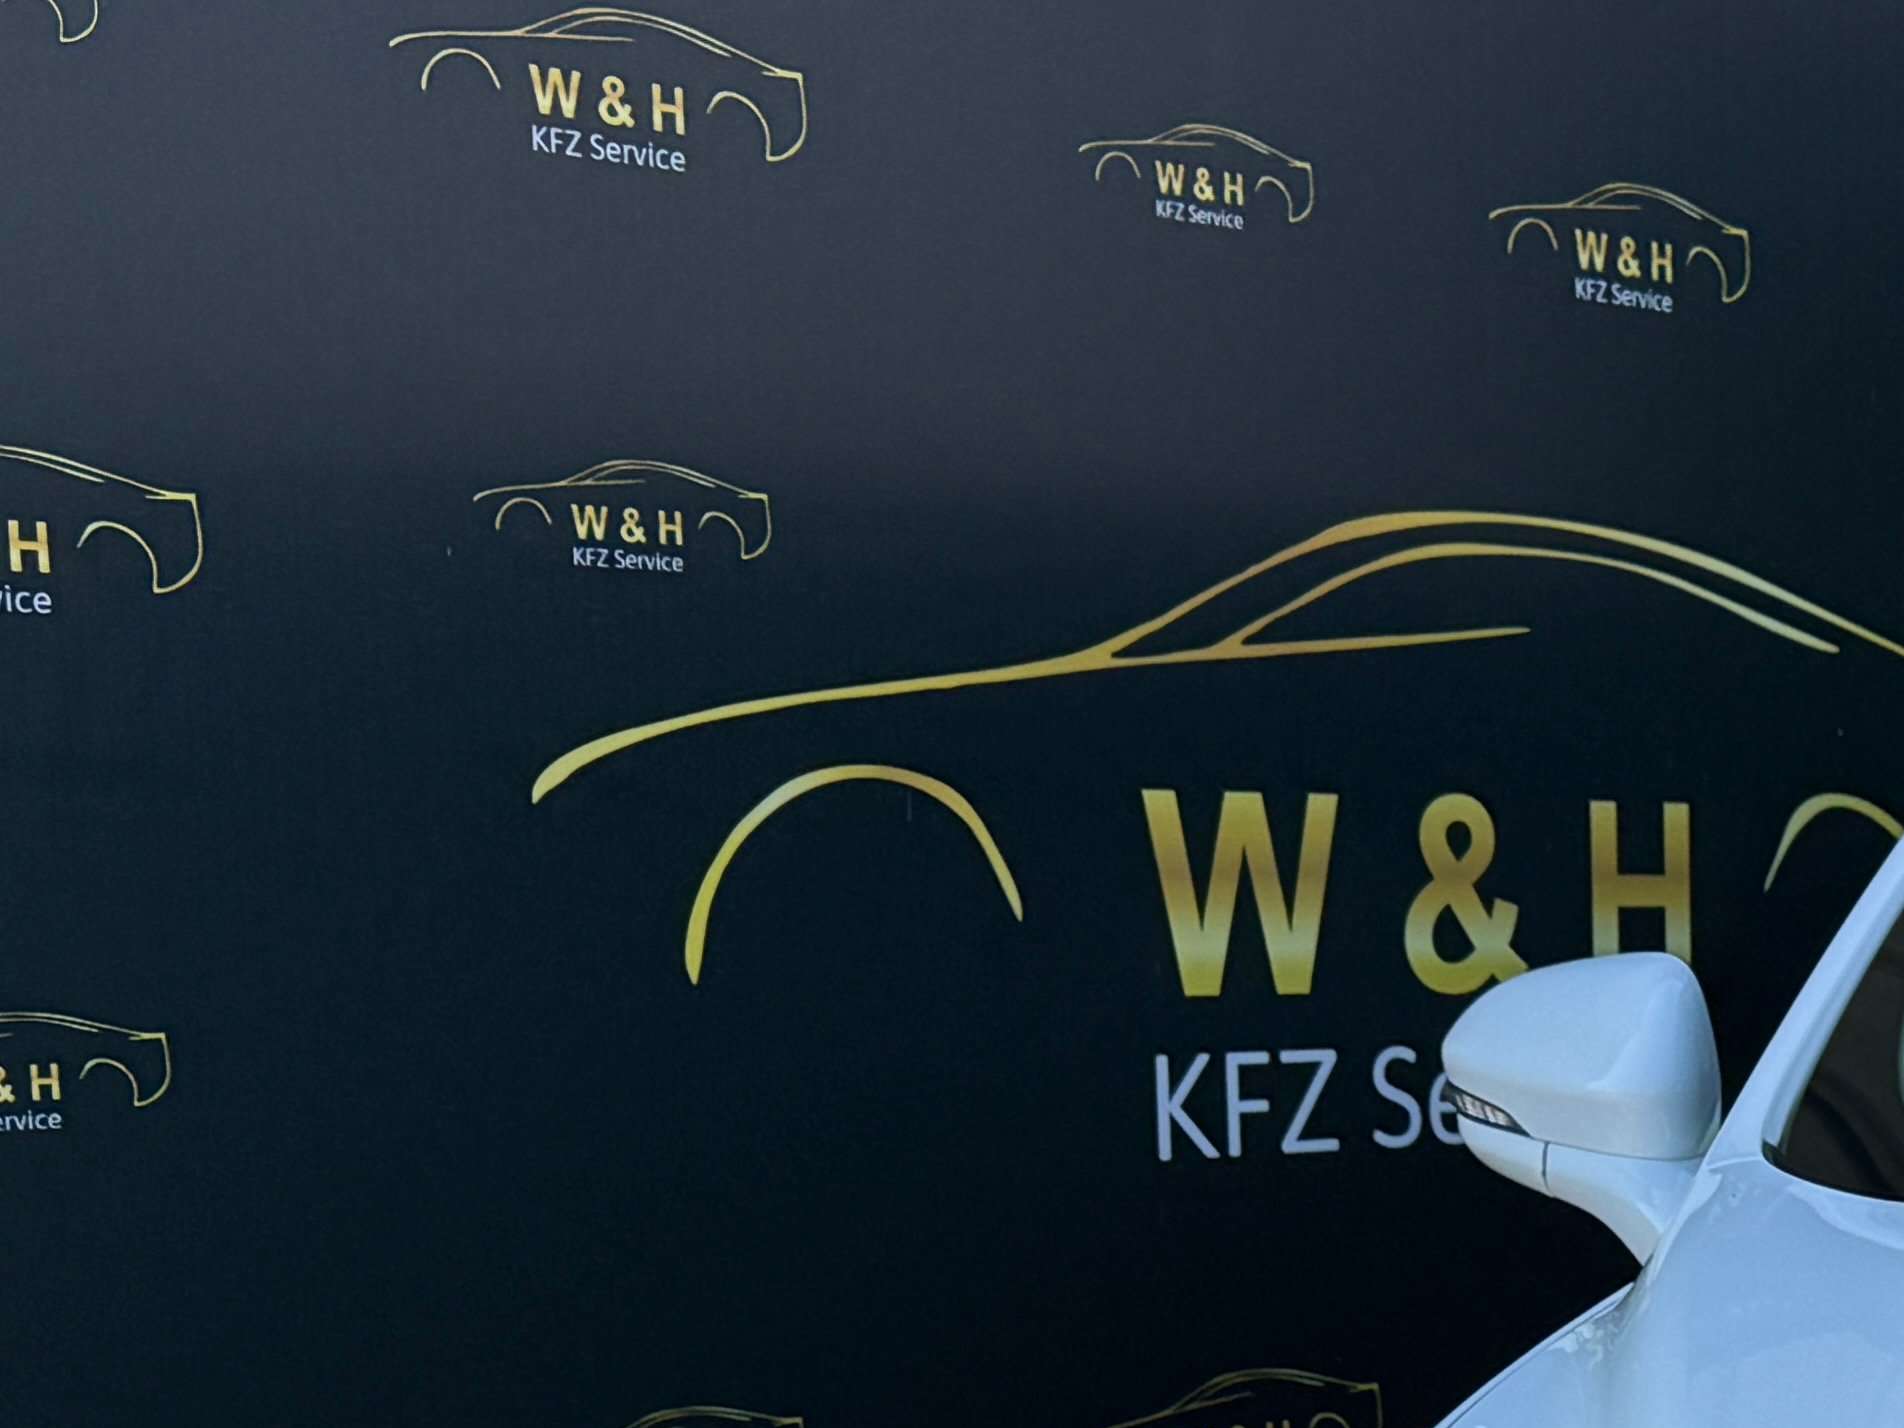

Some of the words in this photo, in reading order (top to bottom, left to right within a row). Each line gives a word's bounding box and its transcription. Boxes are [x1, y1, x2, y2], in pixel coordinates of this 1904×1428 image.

[528, 63, 581, 119] W
[598, 75, 635, 128] &
[651, 83, 685, 136] H
[531, 124, 583, 158] KFZ
[589, 133, 686, 172] Service
[1155, 160, 1185, 196] W
[1193, 167, 1215, 201] &
[1223, 172, 1244, 206] H
[1155, 199, 1185, 221] KFZ
[1187, 204, 1244, 230] Service
[1574, 228, 1609, 273] W
[1617, 236, 1641, 278] &
[1651, 241, 1673, 284] H
[1574, 277, 1608, 304] KFZ
[1610, 283, 1673, 313] Service
[7, 519, 51, 574] H
[570, 503, 608, 541] W
[619, 507, 647, 544] &
[658, 510, 683, 546] H
[572, 546, 609, 568] KFZ
[613, 549, 683, 572] Service
[1141, 788, 1339, 997] W
[1404, 792, 1530, 995] &
[1588, 799, 1693, 962] H
[29, 1062, 61, 1101] H
[1154, 1048, 1340, 1162] KFZ
